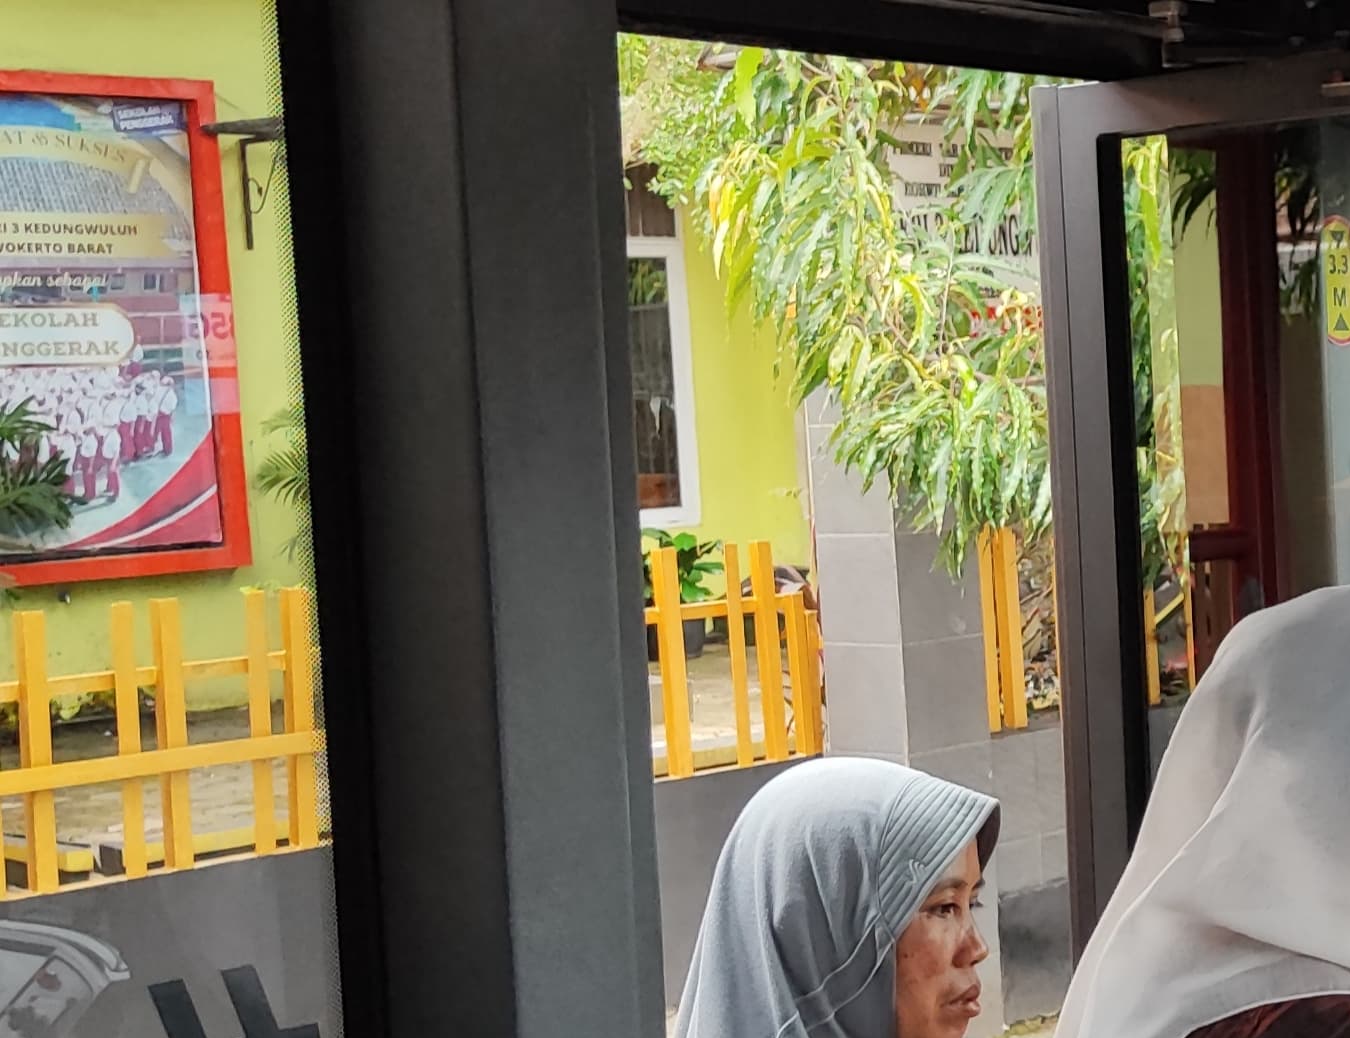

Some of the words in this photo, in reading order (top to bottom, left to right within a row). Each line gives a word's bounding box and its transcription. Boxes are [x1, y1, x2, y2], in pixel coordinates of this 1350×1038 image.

[55, 134, 125, 161] SUKSES
[24, 222, 138, 237] KEDUNGWULUH
[67, 243, 113, 255] BARAT
[1328, 253, 1349, 275] 3.3
[1332, 286, 1348, 307] M
